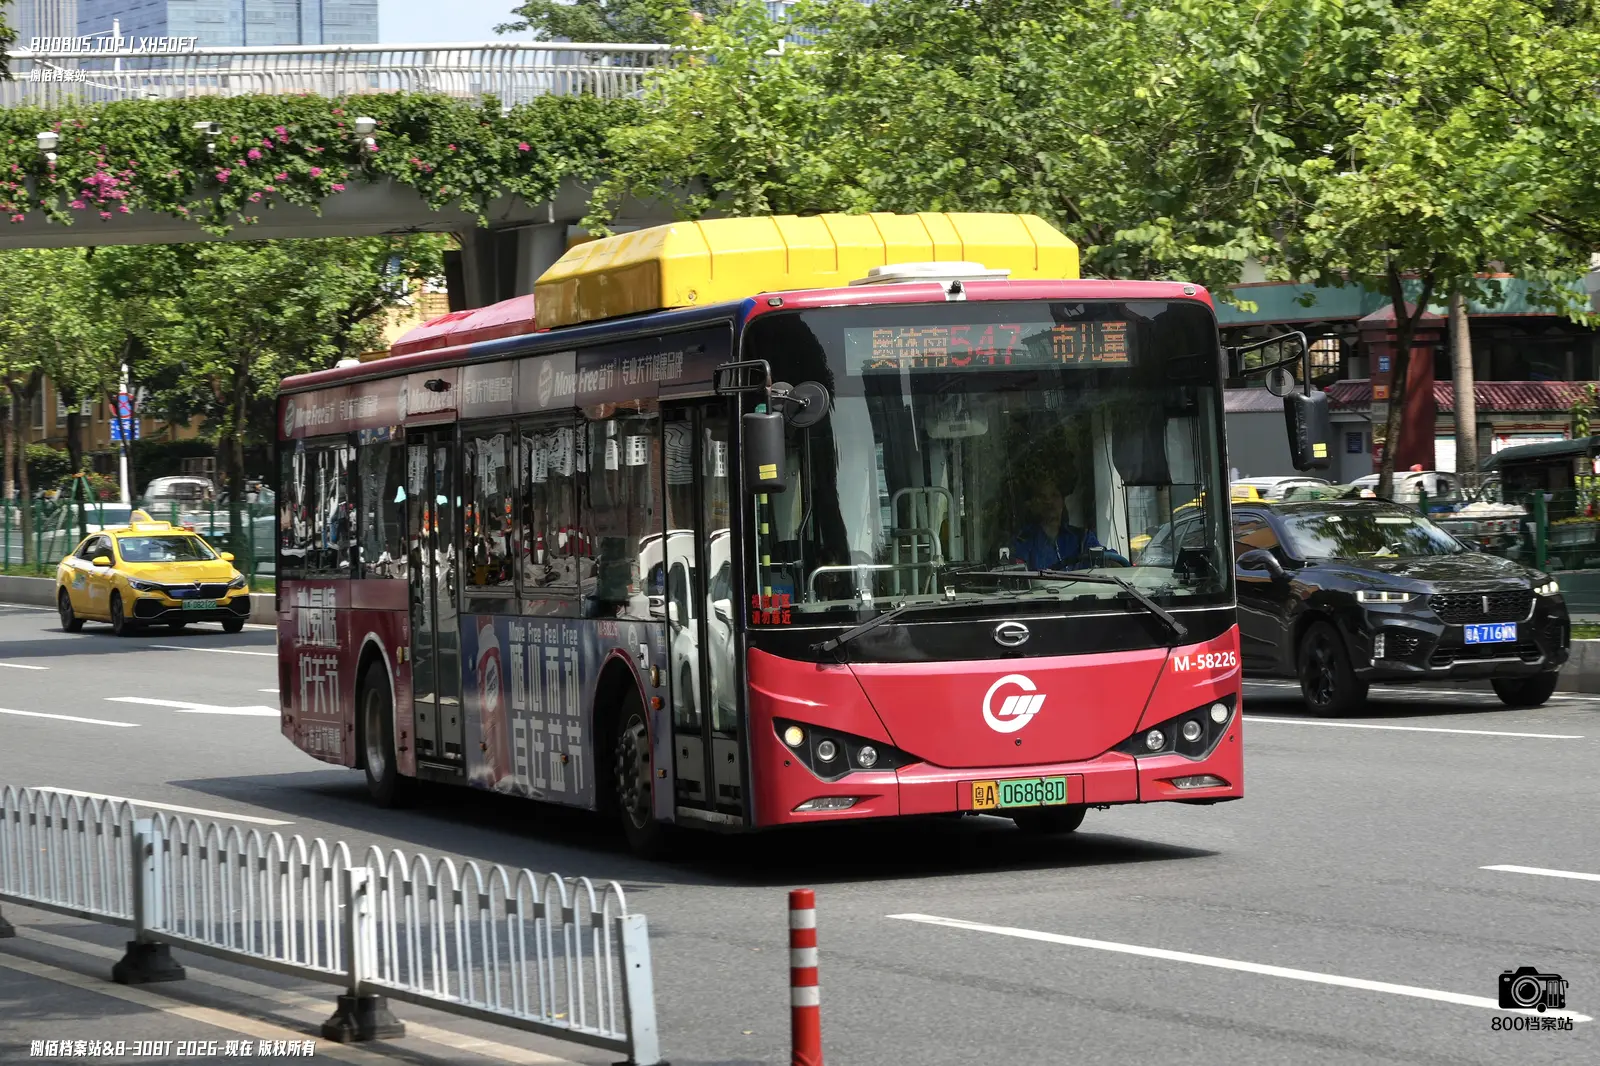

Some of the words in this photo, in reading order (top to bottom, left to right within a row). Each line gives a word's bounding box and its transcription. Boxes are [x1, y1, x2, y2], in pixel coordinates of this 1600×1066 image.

[950, 324, 1021, 367] 547
[554, 371, 577, 397] Move
[622, 350, 684, 386] 专业关节健康品牌
[508, 621, 526, 643] Move
[528, 622, 542, 644] Free
[544, 623, 559, 644] Feel
[562, 624, 578, 645] Free
[299, 653, 340, 715] 护关节
[509, 643, 581, 717] 随心而动
[1173, 651, 1237, 672] M-58226
[511, 711, 584, 795] 自在益节
[975, 785, 995, 806] 粤A
[1003, 780, 1065, 804] 06868D
